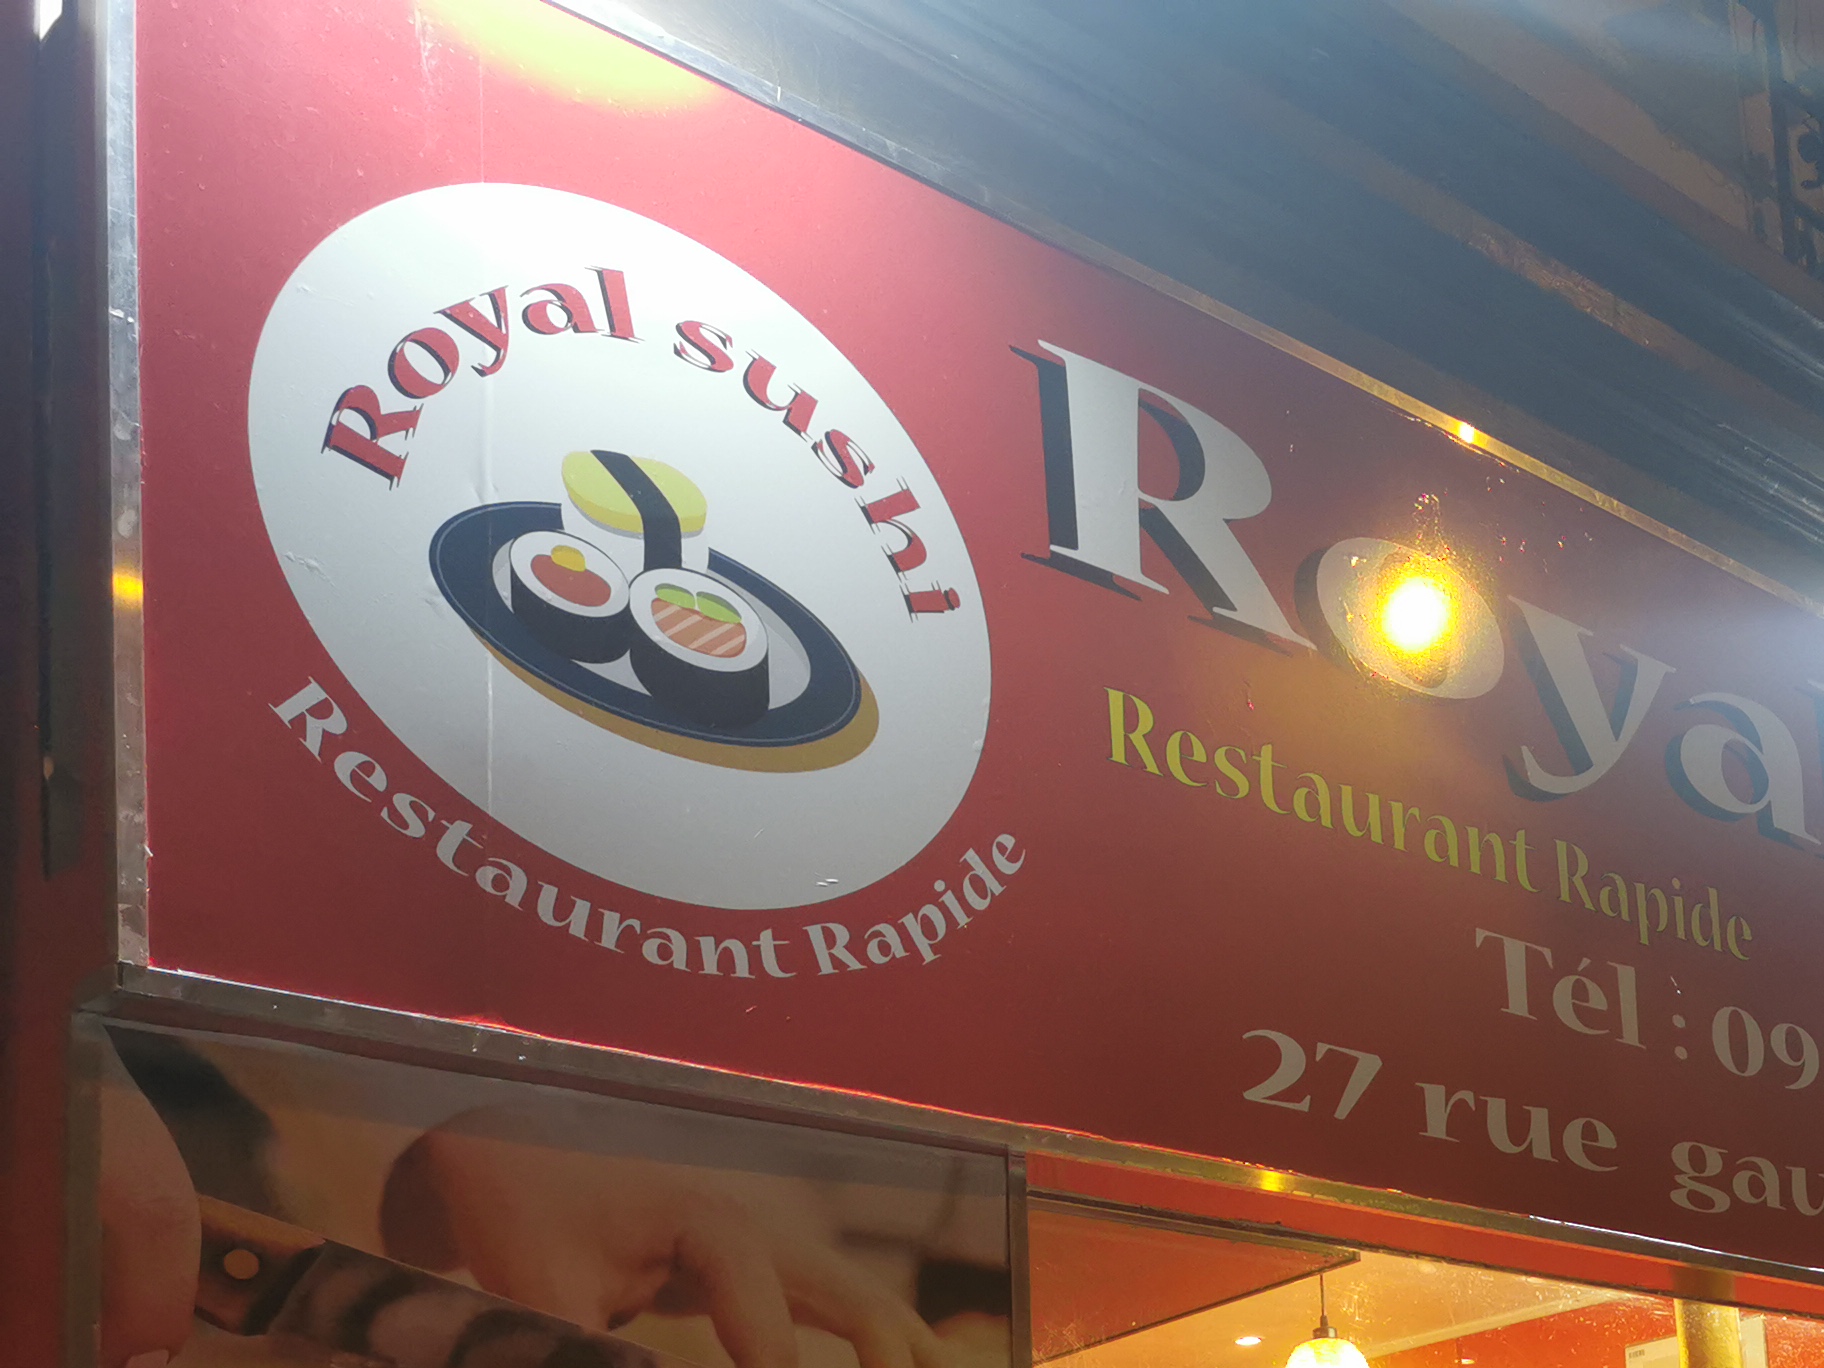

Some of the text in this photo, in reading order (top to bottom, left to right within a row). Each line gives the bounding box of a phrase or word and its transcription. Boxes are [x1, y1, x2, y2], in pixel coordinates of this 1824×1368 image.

[321, 266, 963, 623] Royal sushi
[268, 676, 1026, 979] Restaurant Rapide
[1103, 686, 1753, 960] Restaurant Rapide
[1242, 1029, 1382, 1121] 27
[1415, 1082, 1619, 1173] rue
[1475, 928, 1646, 1049] Tél
[1711, 1006, 1820, 1090] 09
